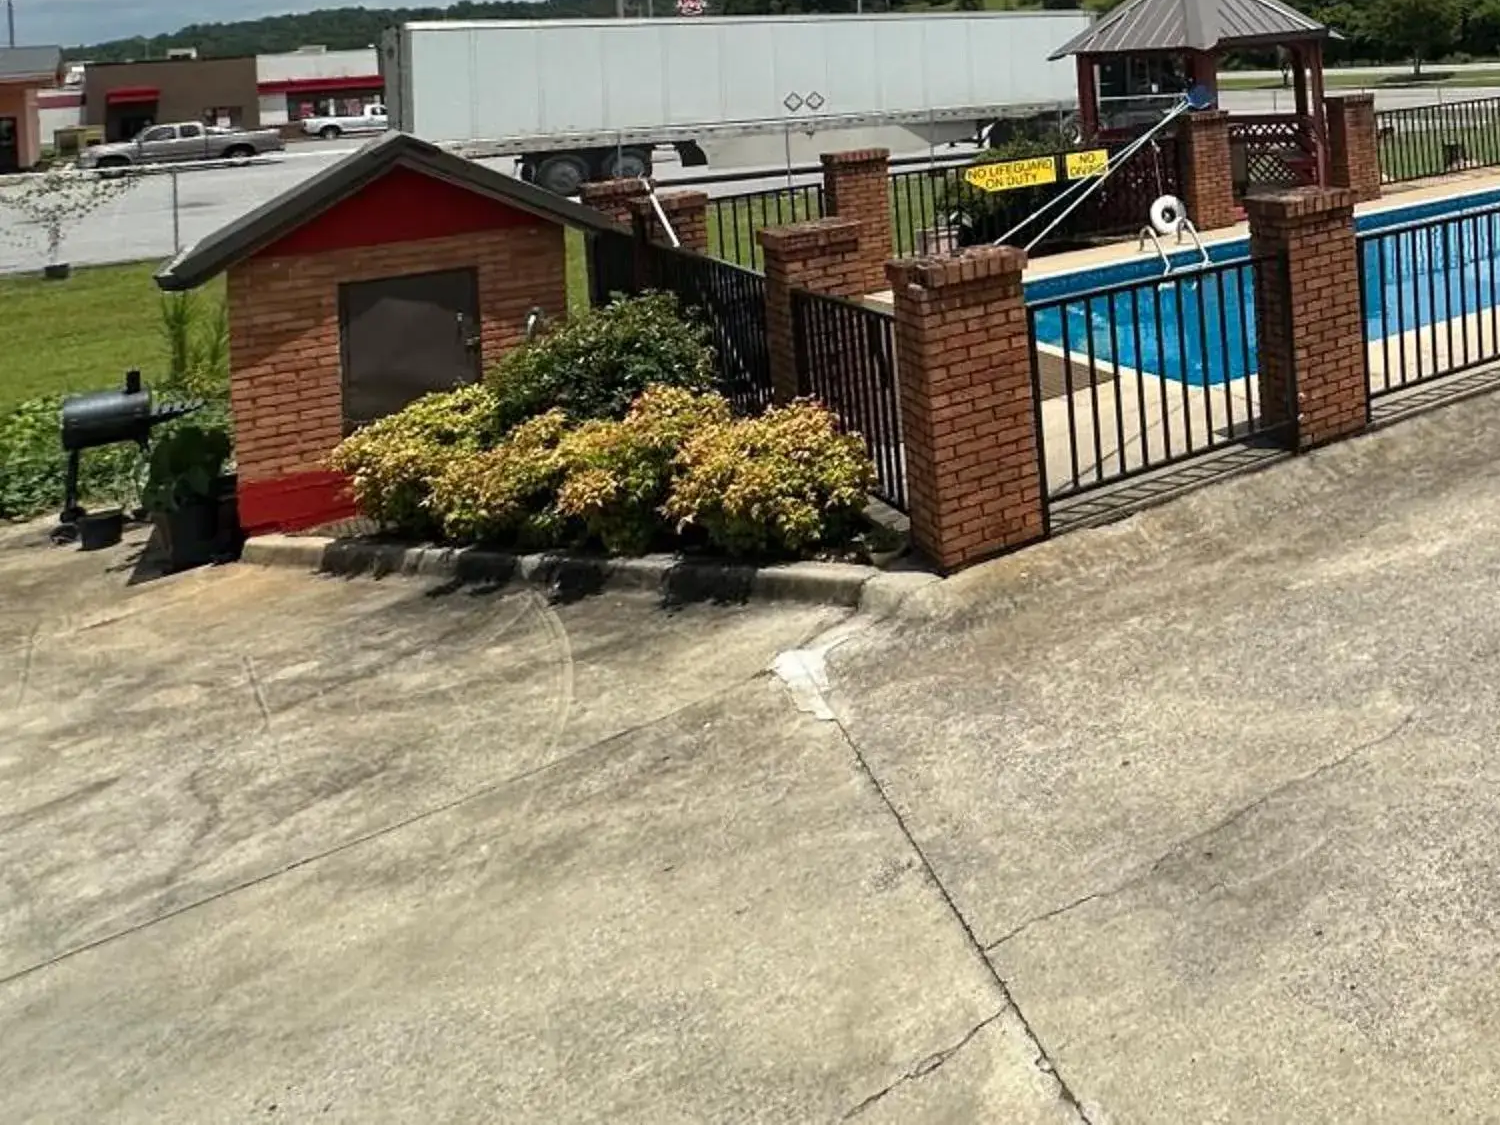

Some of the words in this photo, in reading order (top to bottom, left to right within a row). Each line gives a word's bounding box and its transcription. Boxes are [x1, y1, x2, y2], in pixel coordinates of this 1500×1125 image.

[1080, 152, 1096, 163] NO
[967, 169, 987, 180] NO
[985, 177, 1003, 189] ON
[1006, 172, 1037, 186] DUTY
